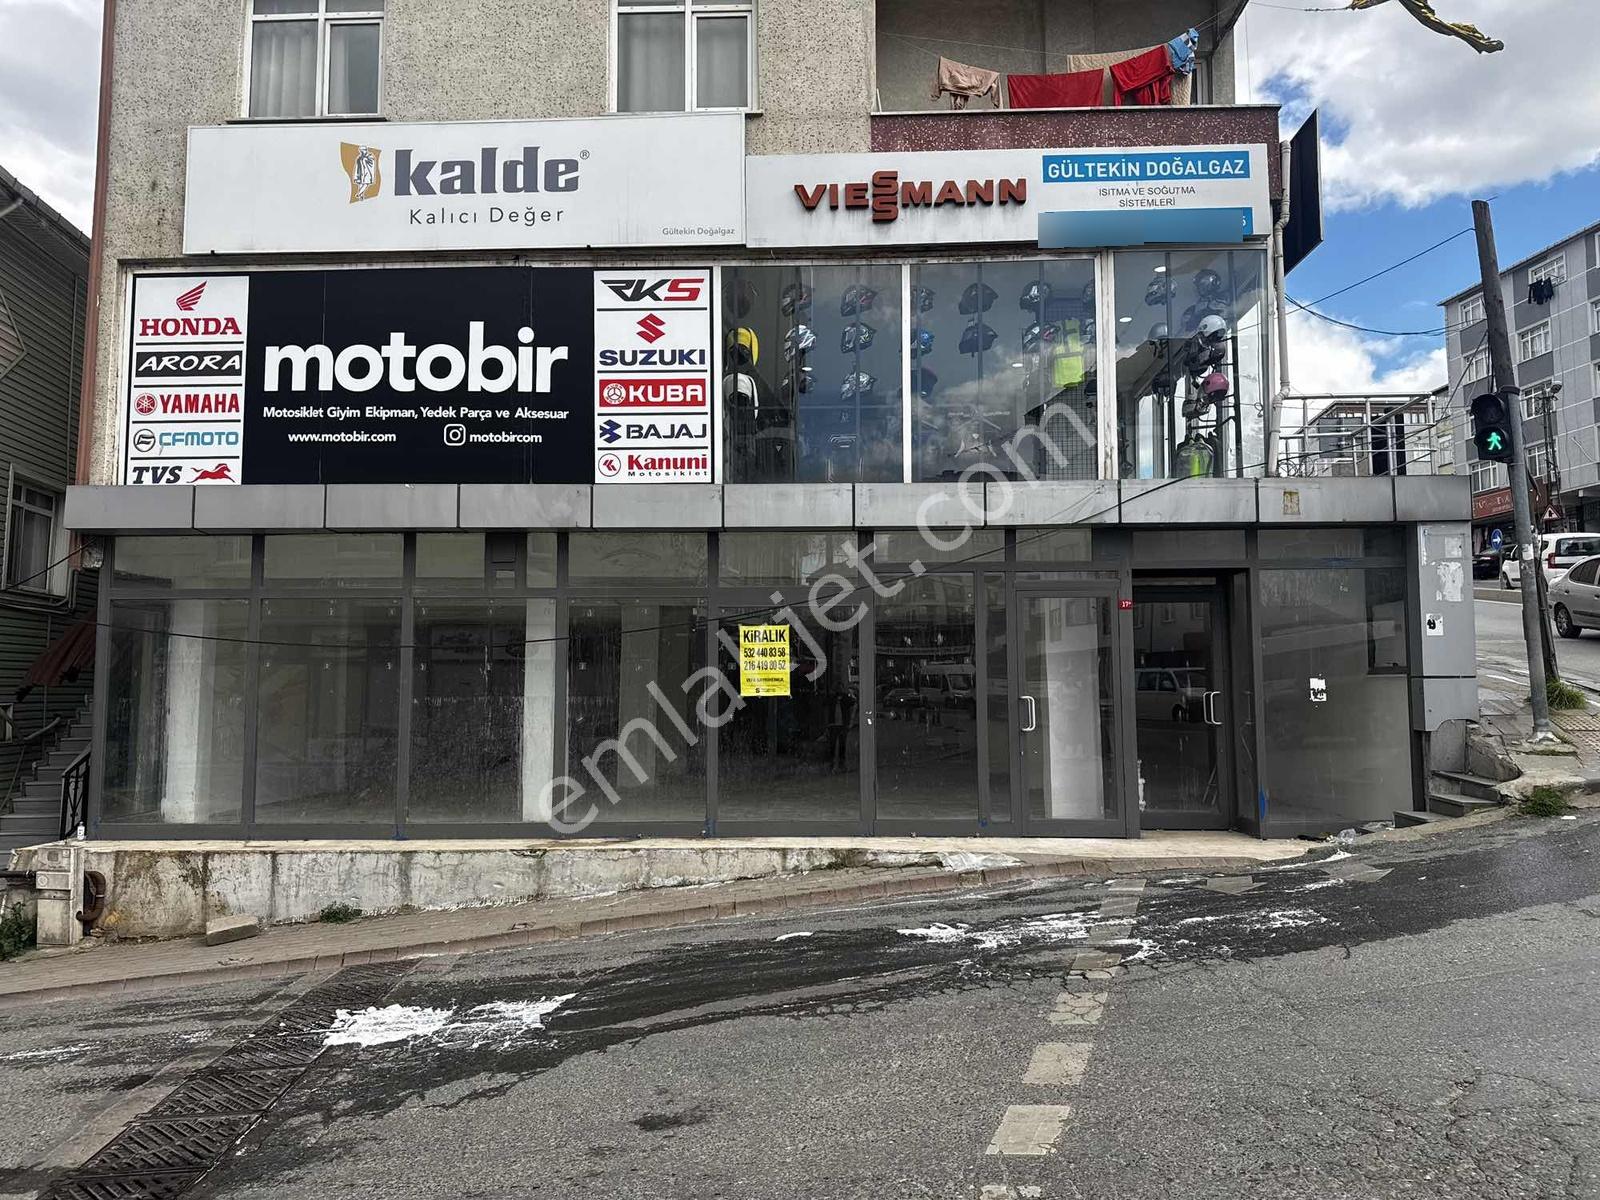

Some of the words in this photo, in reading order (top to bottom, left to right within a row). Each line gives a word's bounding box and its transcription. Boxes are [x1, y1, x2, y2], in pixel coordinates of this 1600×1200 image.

[394, 146, 580, 196] kalde
[1048, 158, 1140, 178] GÜLTEKİN
[1147, 156, 1245, 177] DOĞALGAZ
[794, 170, 1027, 222] VIESSMANN
[1098, 187, 1131, 196] ISITMA
[1132, 187, 1145, 195] VE
[1147, 185, 1196, 196] SOĞUTMA
[1119, 197, 1176, 208] SİSTEMLERİ
[409, 207, 477, 225] Kalıcı
[489, 206, 564, 226] Değer
[662, 227, 696, 236] Gültekin
[697, 226, 735, 237] Doğalgaz
[600, 278, 705, 302] RKS
[139, 317, 242, 337] HONDA
[137, 354, 241, 371] ARORA
[264, 321, 569, 393] motobir
[599, 349, 706, 366] SUZUKI
[628, 384, 703, 402] KUBA
[159, 393, 240, 414] YAMAHA
[263, 406, 324, 418] Motosiklet
[326, 406, 360, 421] Giyim
[365, 406, 418, 421] Ekipman,
[420, 406, 457, 418] Yedek
[460, 406, 492, 421] Parça
[495, 409, 510, 418] ve
[514, 406, 569, 419] Aksesuar
[159, 431, 239, 447] CFMOTO
[288, 430, 397, 442] www.motobir.com
[469, 431, 542, 443] motobircom
[626, 423, 707, 439] BAJAJ
[627, 454, 708, 470] Kanuni
[132, 465, 183, 484] TVS
[743, 647, 755, 658] 532
[778, 647, 786, 658] 58
